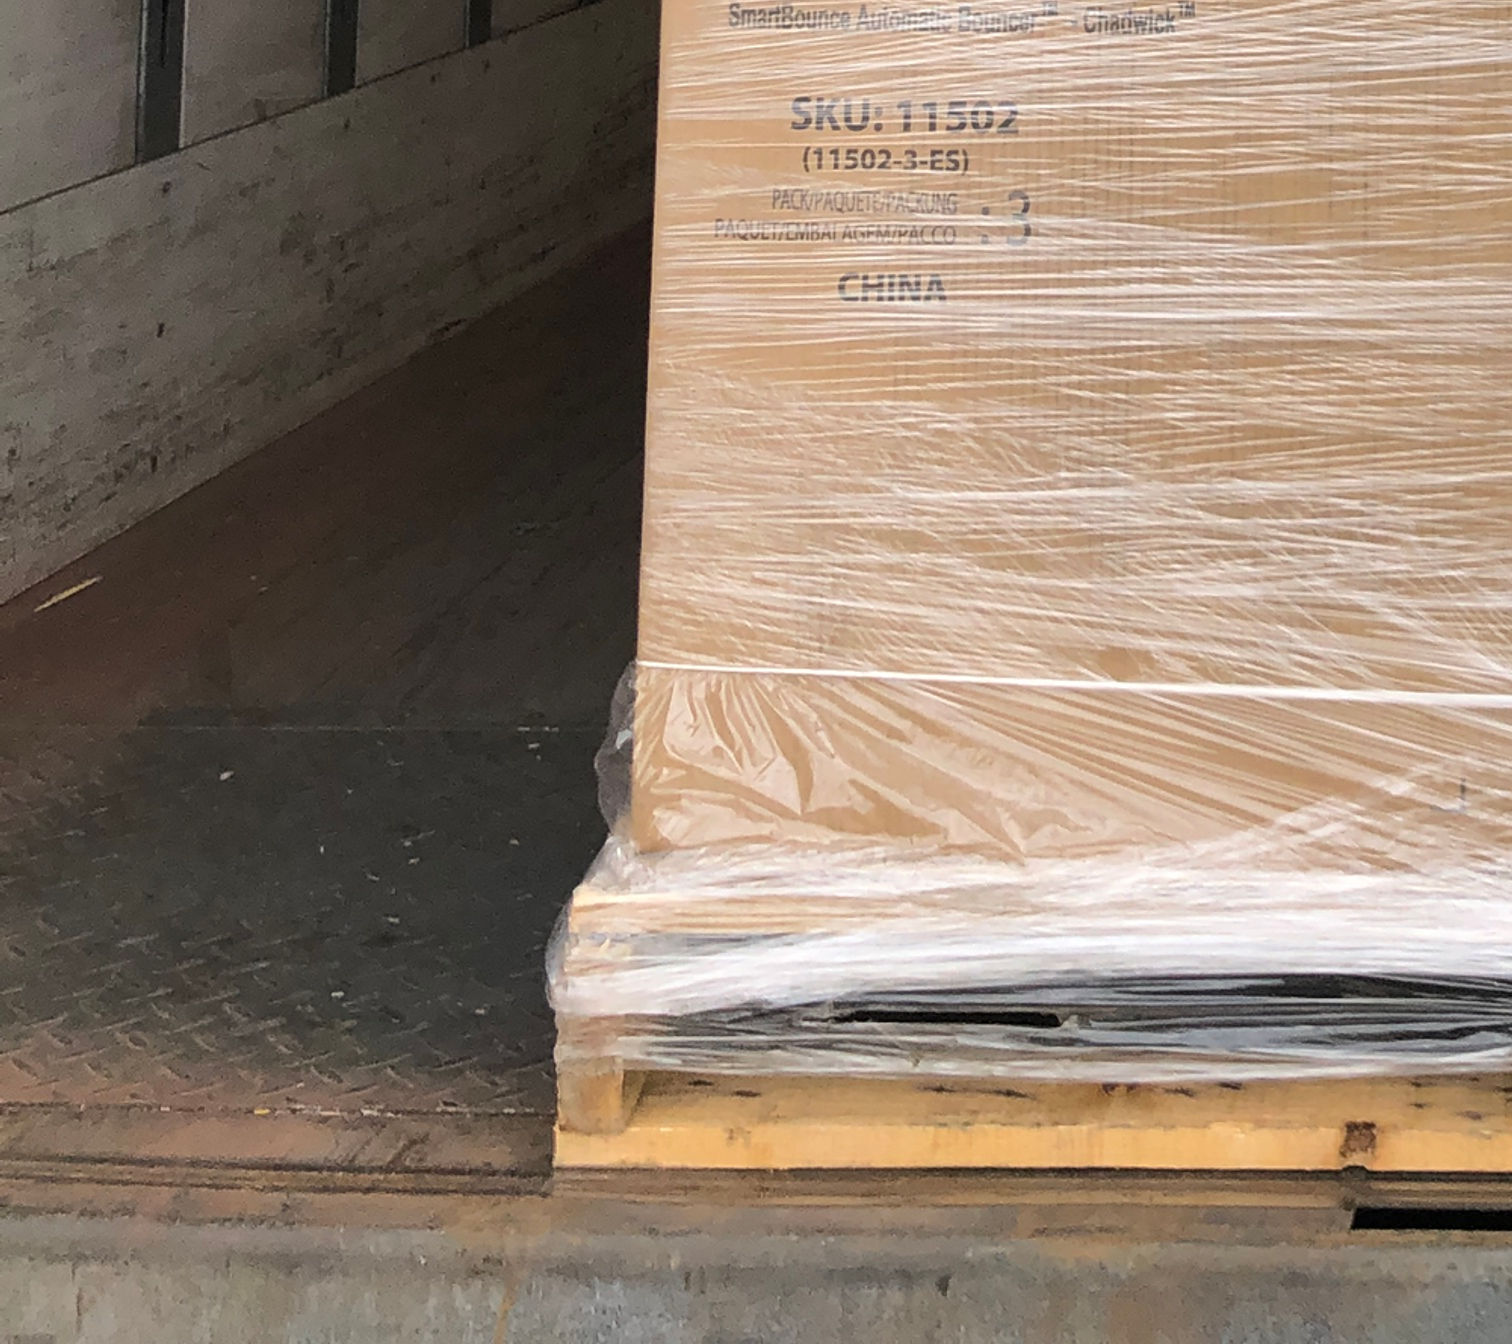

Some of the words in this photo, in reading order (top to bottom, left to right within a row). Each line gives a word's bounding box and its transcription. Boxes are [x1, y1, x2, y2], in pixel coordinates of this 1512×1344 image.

[728, 2, 852, 32] SmartBounce
[856, 3, 953, 33] Automatic
[790, 95, 884, 133] SKU:
[897, 98, 1020, 135] 11502
[802, 146, 970, 176] (11502-3-ES)
[837, 271, 948, 304] CHINA
